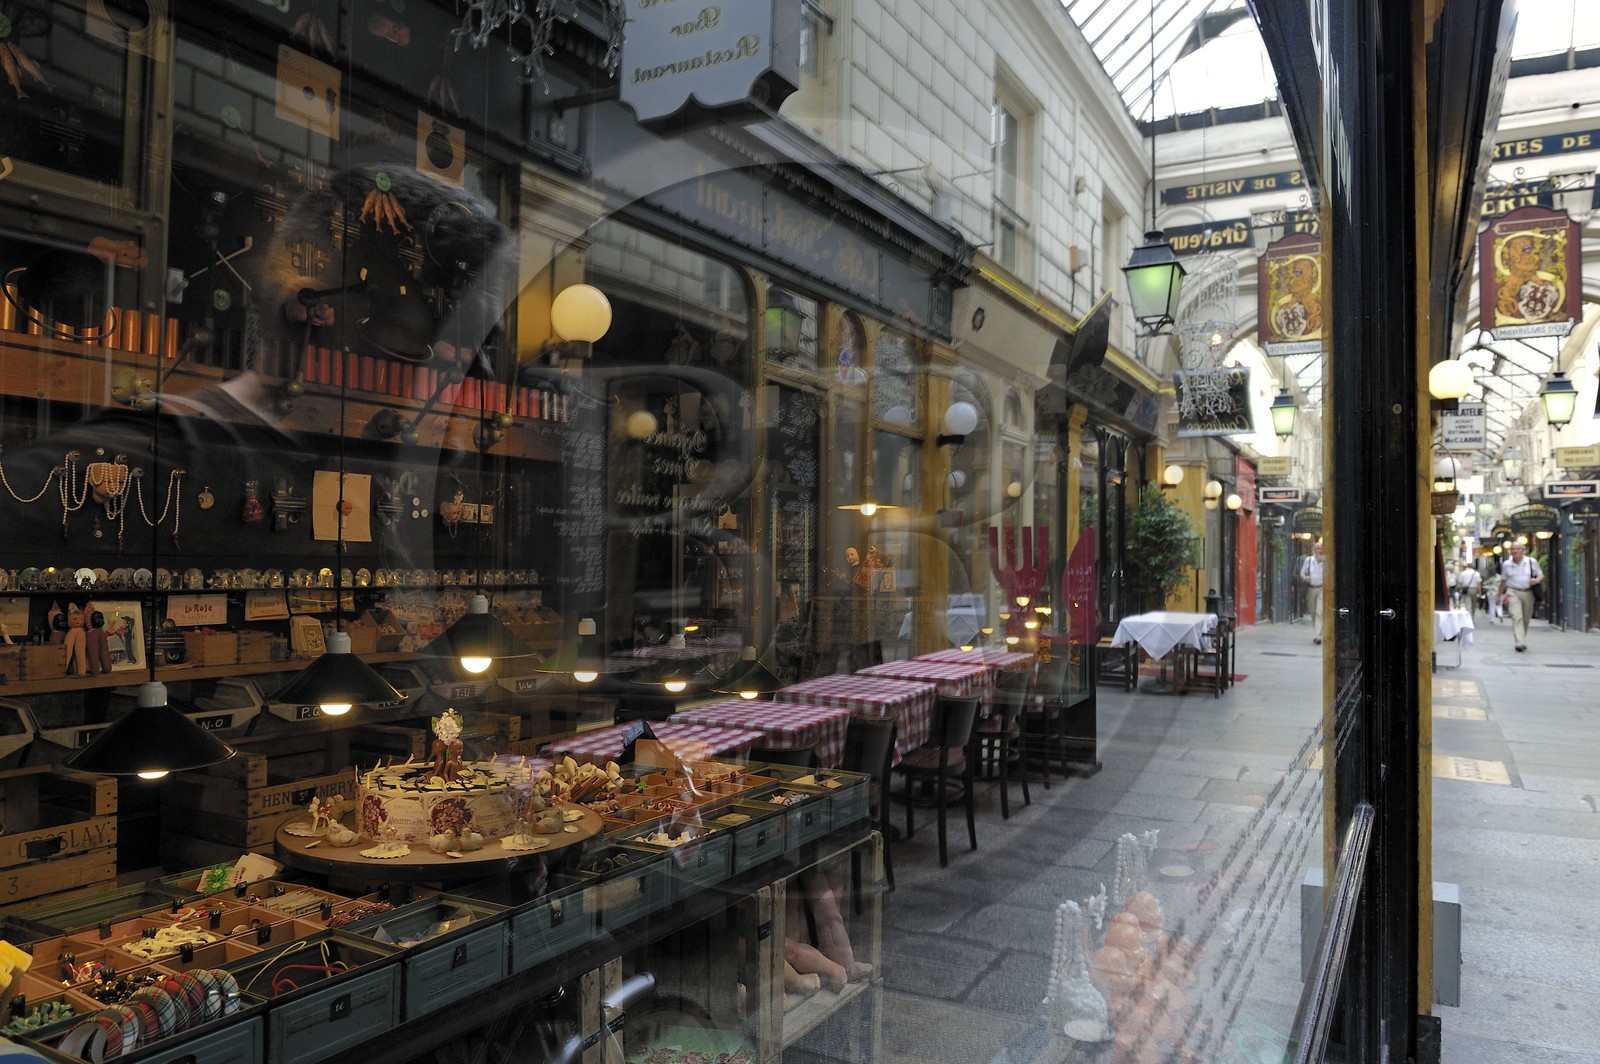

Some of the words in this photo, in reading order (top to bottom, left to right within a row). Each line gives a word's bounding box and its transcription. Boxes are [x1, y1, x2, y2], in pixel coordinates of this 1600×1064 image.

[1492, 138, 1543, 159] RTES
[1561, 134, 1592, 149] DE
[18, 822, 107, 858] CSLAY
[7, 876, 19, 895] 3
